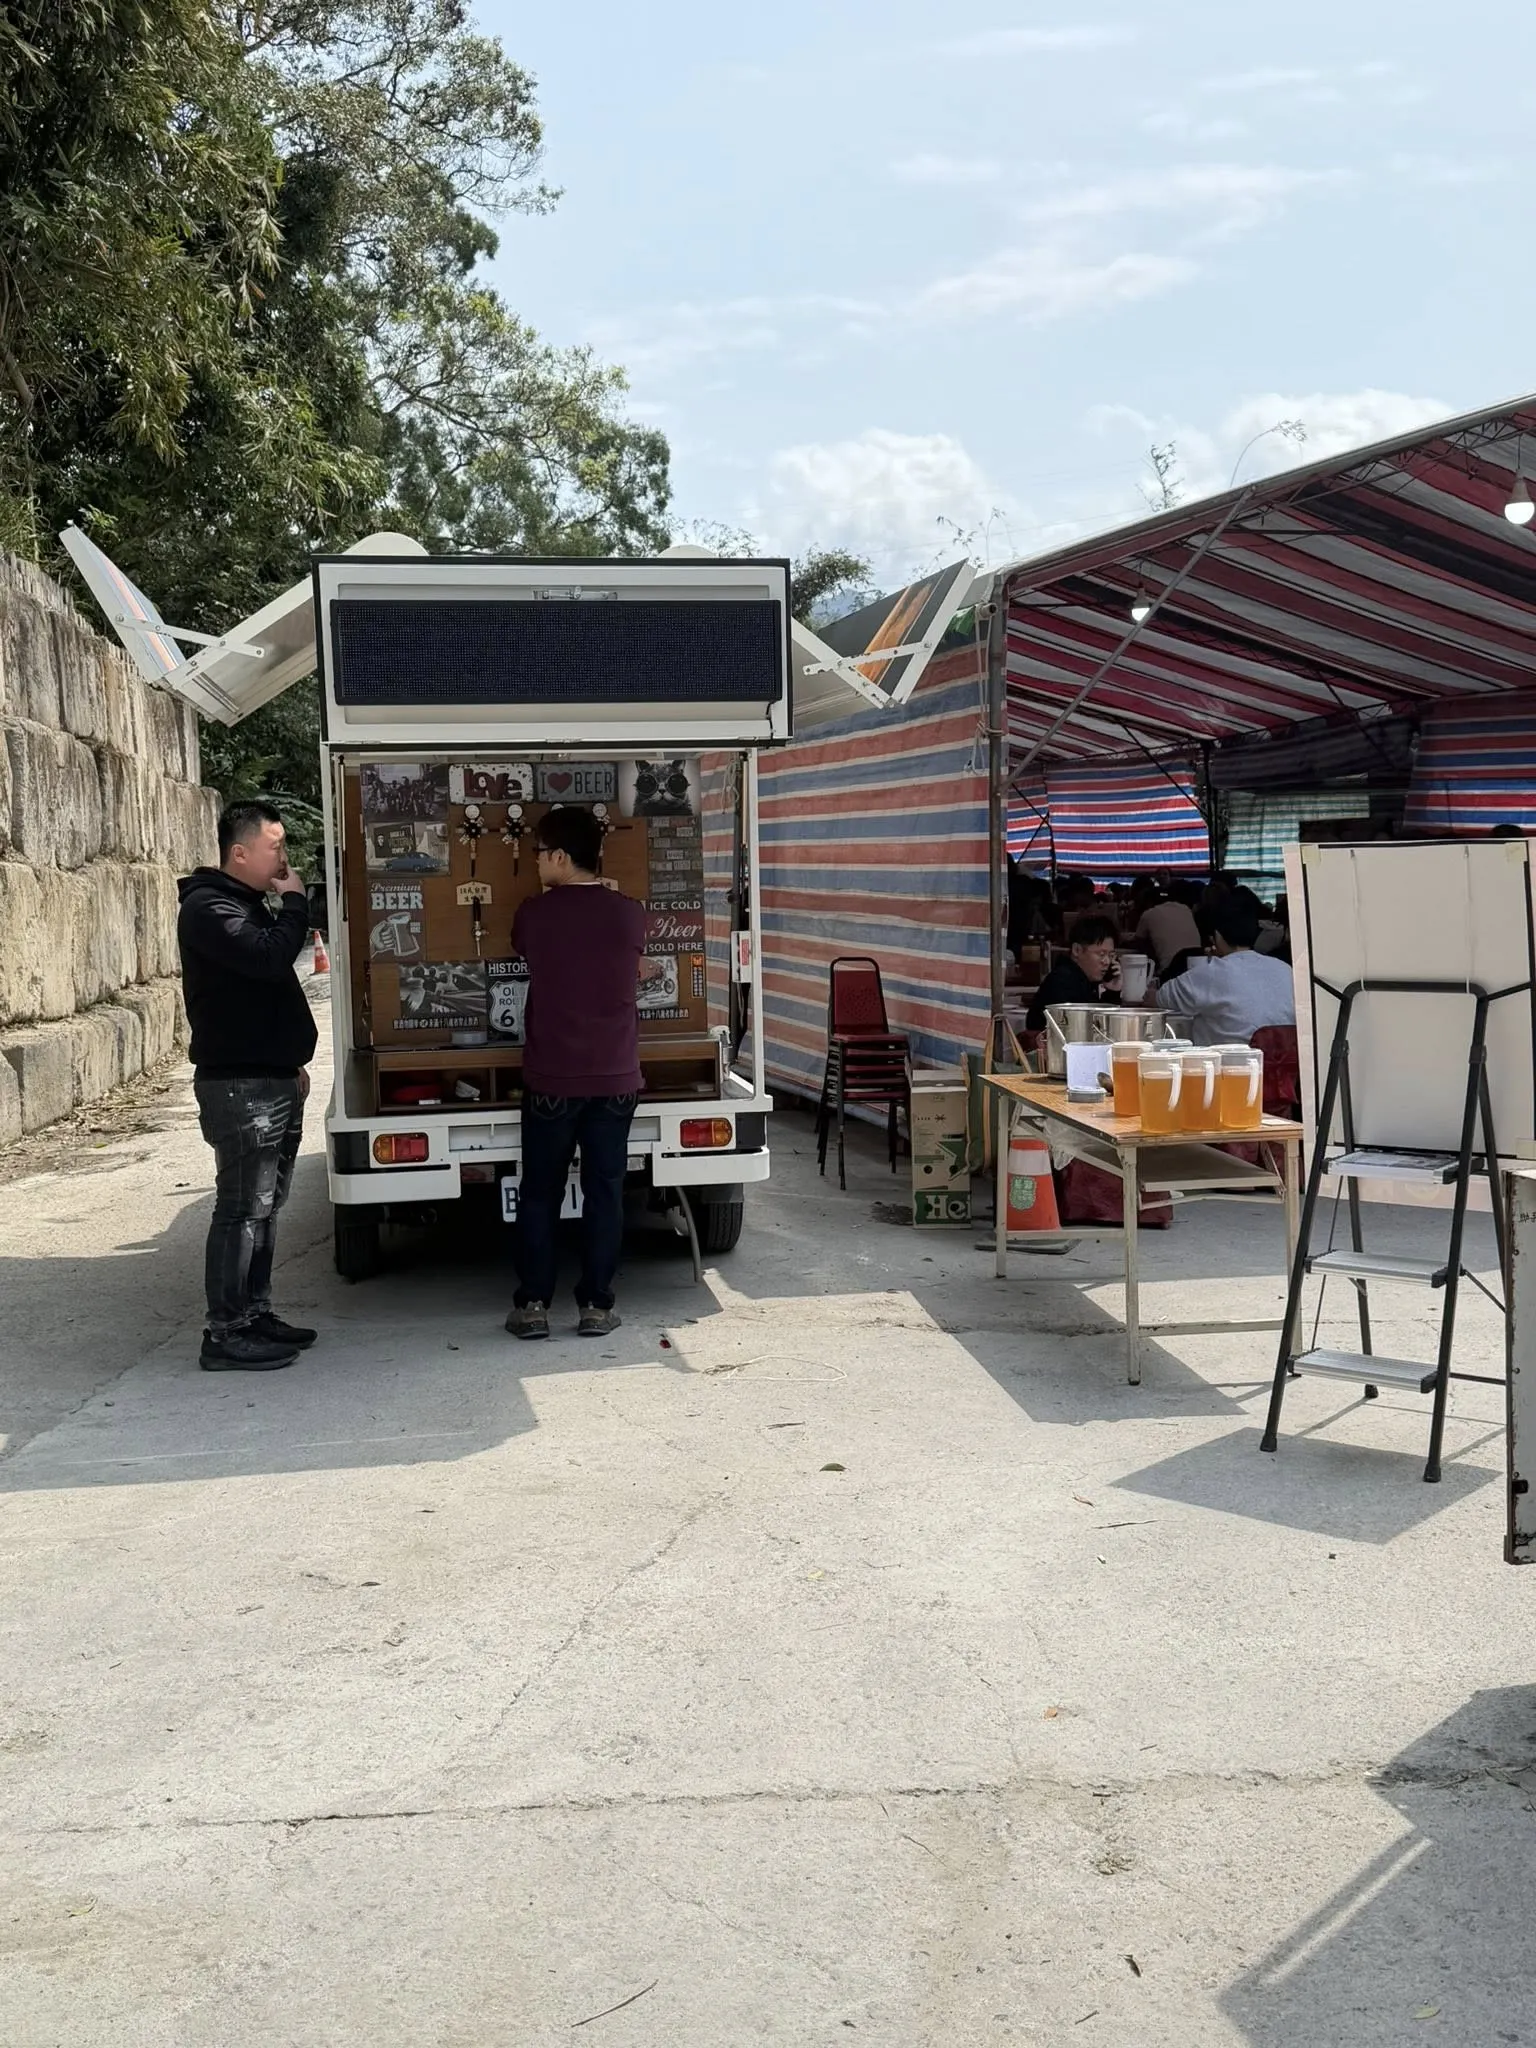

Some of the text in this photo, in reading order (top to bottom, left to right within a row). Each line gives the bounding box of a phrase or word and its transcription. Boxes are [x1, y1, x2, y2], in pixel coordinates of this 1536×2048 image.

[541, 771, 613, 794] I BEER
[371, 883, 420, 892] Premium
[371, 892, 423, 910] BEER
[650, 900, 701, 911] ICE COLD
[650, 916, 702, 939] Beer
[649, 942, 703, 952] SOLD HERE
[488, 962, 529, 974] HISTOR
